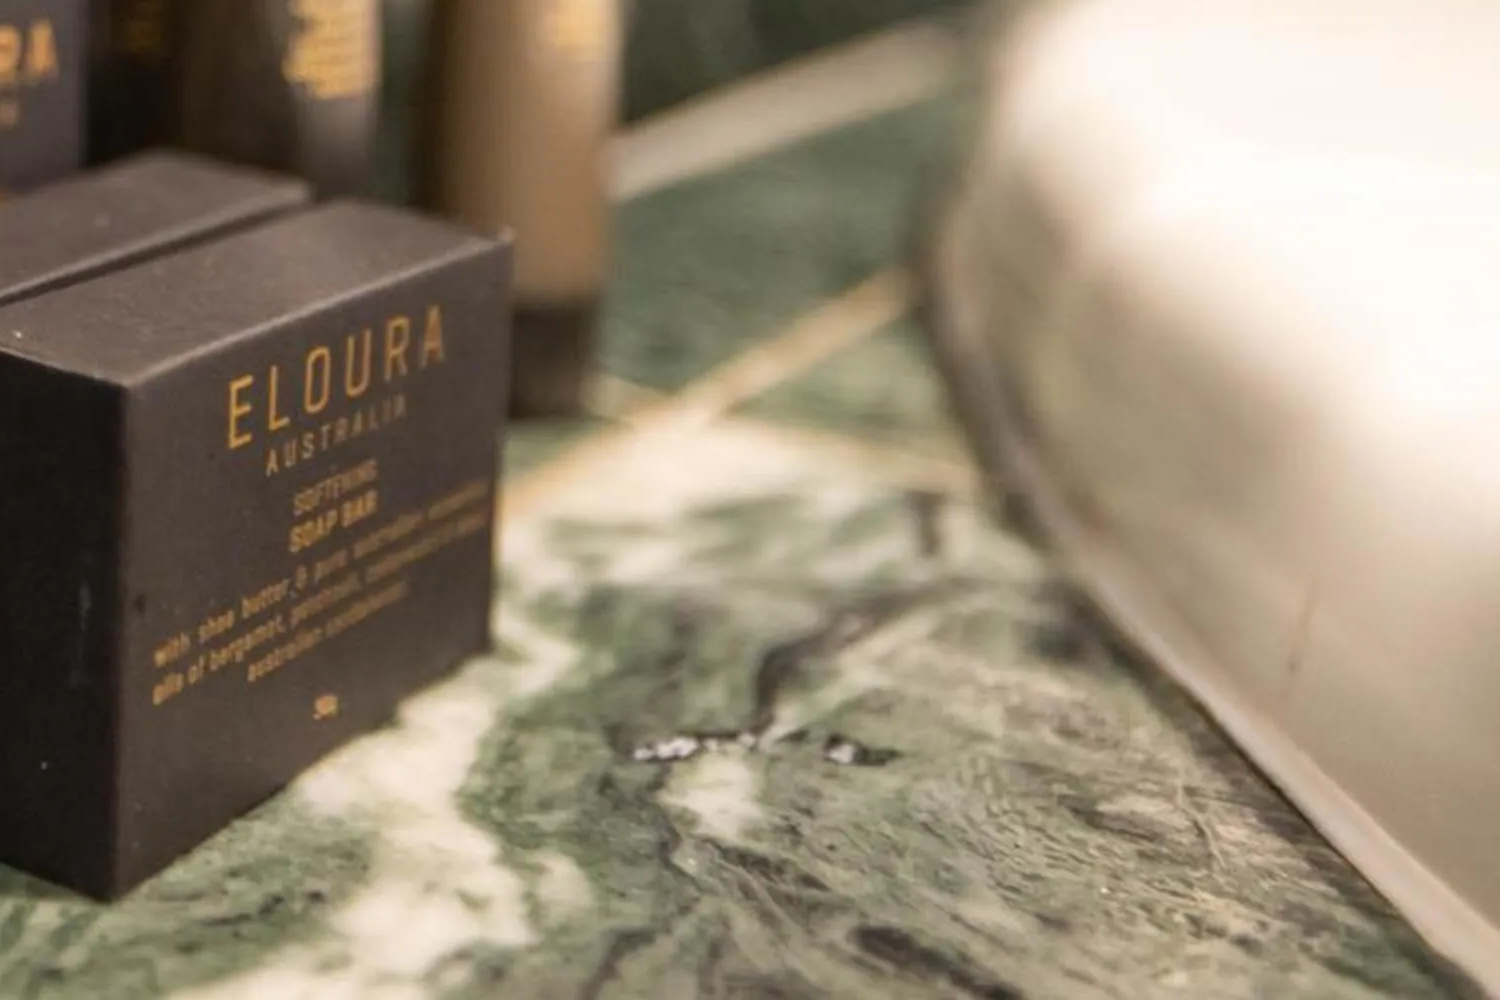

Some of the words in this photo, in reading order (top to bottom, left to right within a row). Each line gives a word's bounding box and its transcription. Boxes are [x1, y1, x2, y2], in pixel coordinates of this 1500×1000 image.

[228, 303, 446, 450] ELOURA
[265, 393, 407, 478] AUSTRALIA
[289, 508, 338, 553] SOAP
[340, 488, 379, 528] BAR
